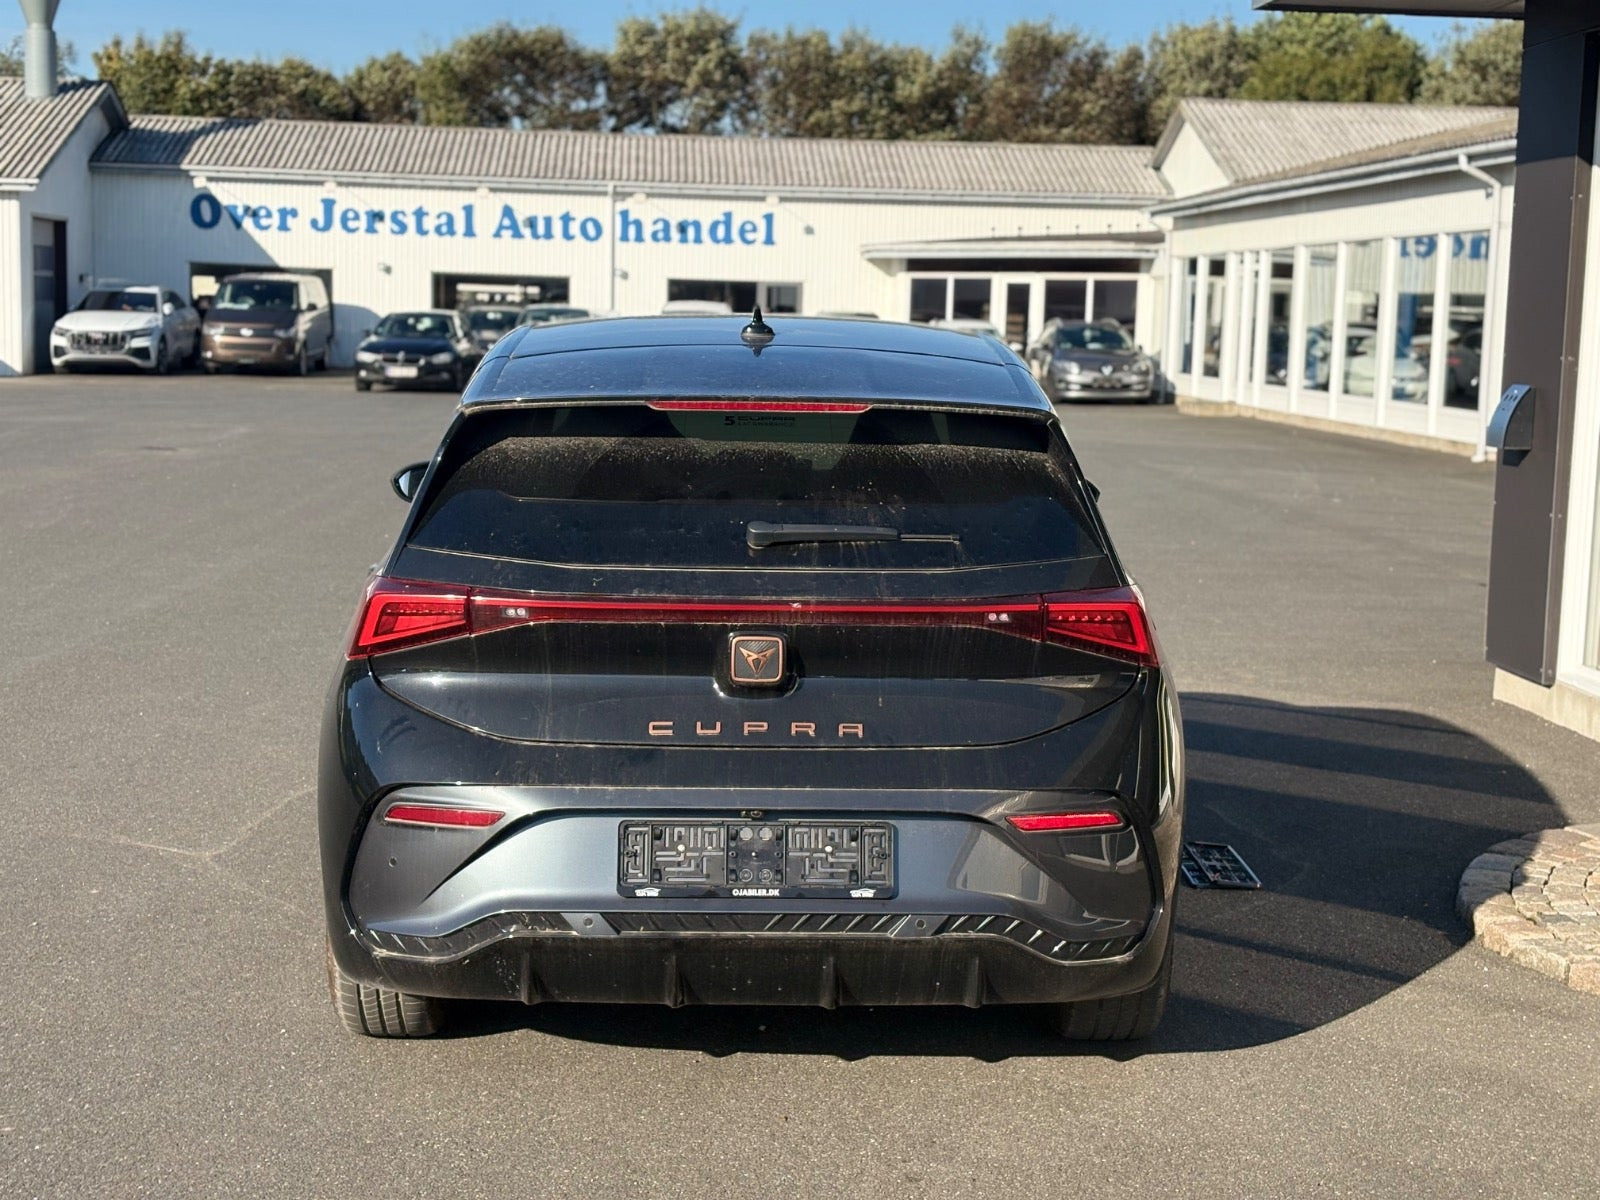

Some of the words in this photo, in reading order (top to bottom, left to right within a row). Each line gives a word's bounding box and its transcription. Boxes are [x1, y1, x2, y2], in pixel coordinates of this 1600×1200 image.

[190, 192, 298, 230] Over
[310, 198, 476, 237] Jerstal
[492, 204, 602, 241] Auto
[619, 209, 776, 246] handel
[648, 721, 863, 738] CUPRA
